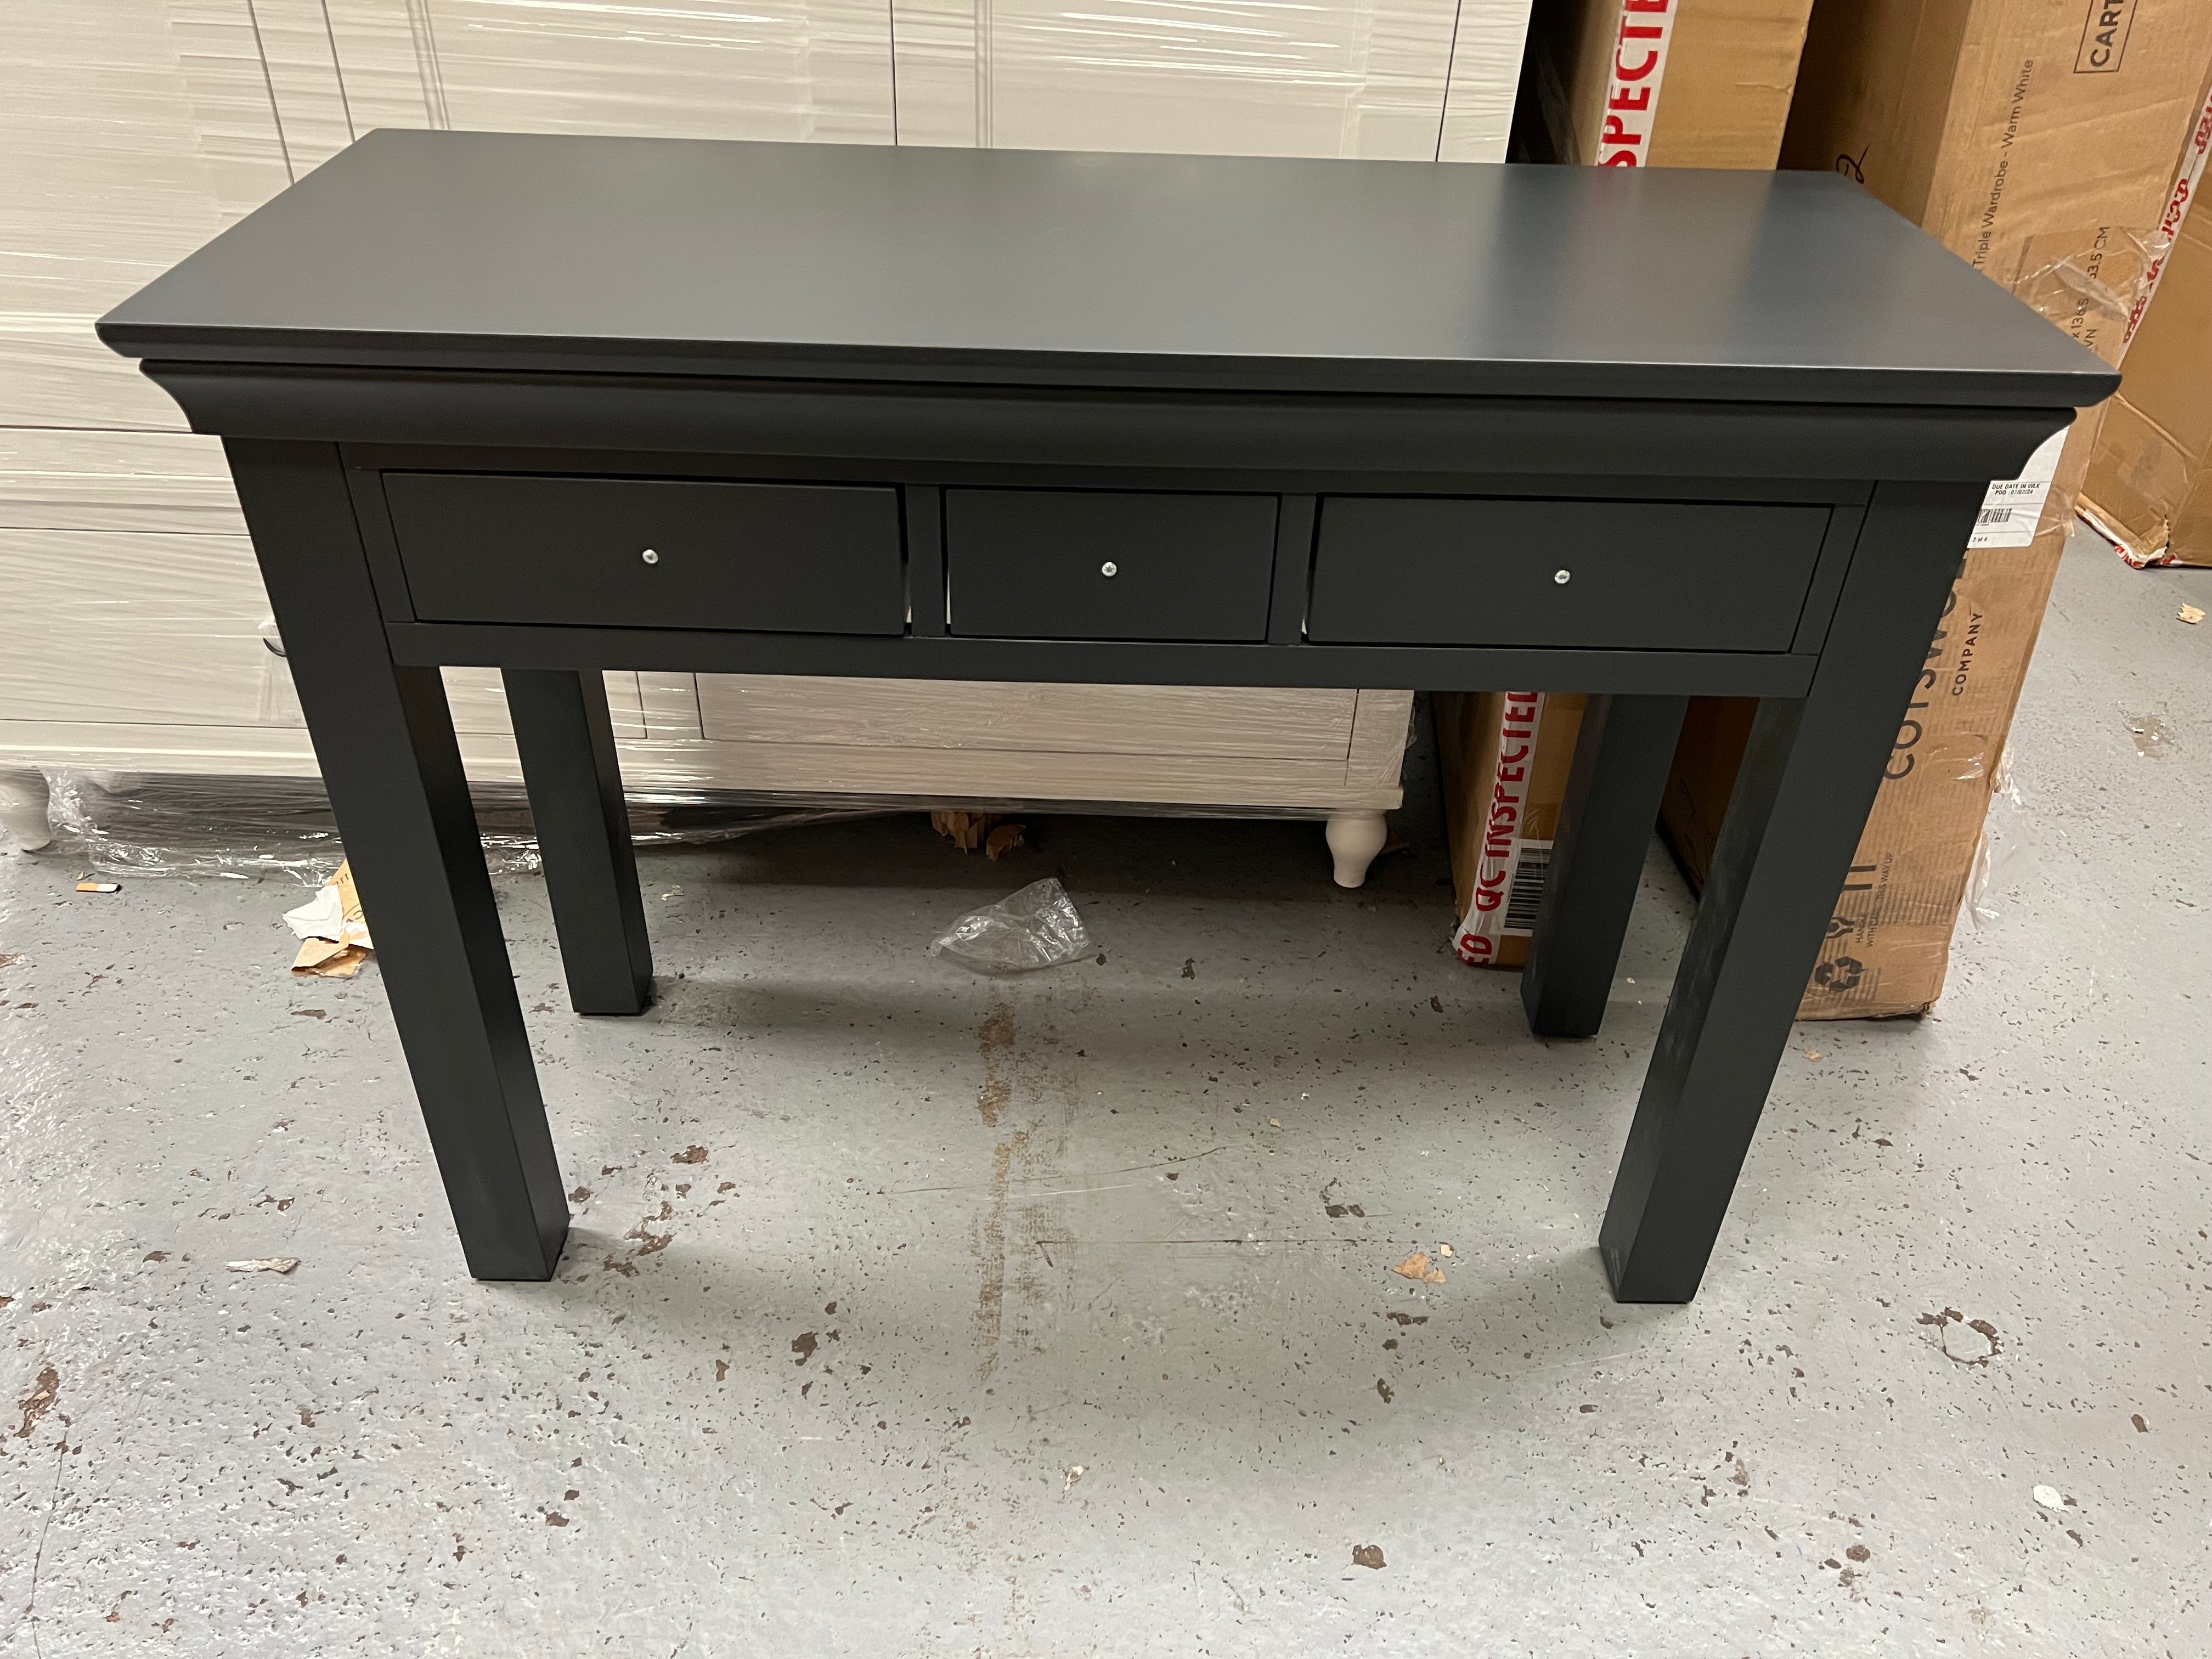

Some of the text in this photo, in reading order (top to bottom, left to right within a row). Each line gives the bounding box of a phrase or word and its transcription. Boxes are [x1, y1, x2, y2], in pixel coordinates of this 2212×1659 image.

[2011, 59, 2033, 104] White
[2001, 106, 2022, 149] Warm
[1981, 160, 2008, 228] Wardrobe
[1972, 231, 1991, 268] Triple
[2094, 227, 2111, 250] CM
[1951, 612, 1983, 696] COMPANY
[1476, 862, 1506, 911] QC
[1880, 865, 1890, 883] WAY
[1886, 853, 1893, 865] UP
[1866, 926, 1876, 948] WITH
